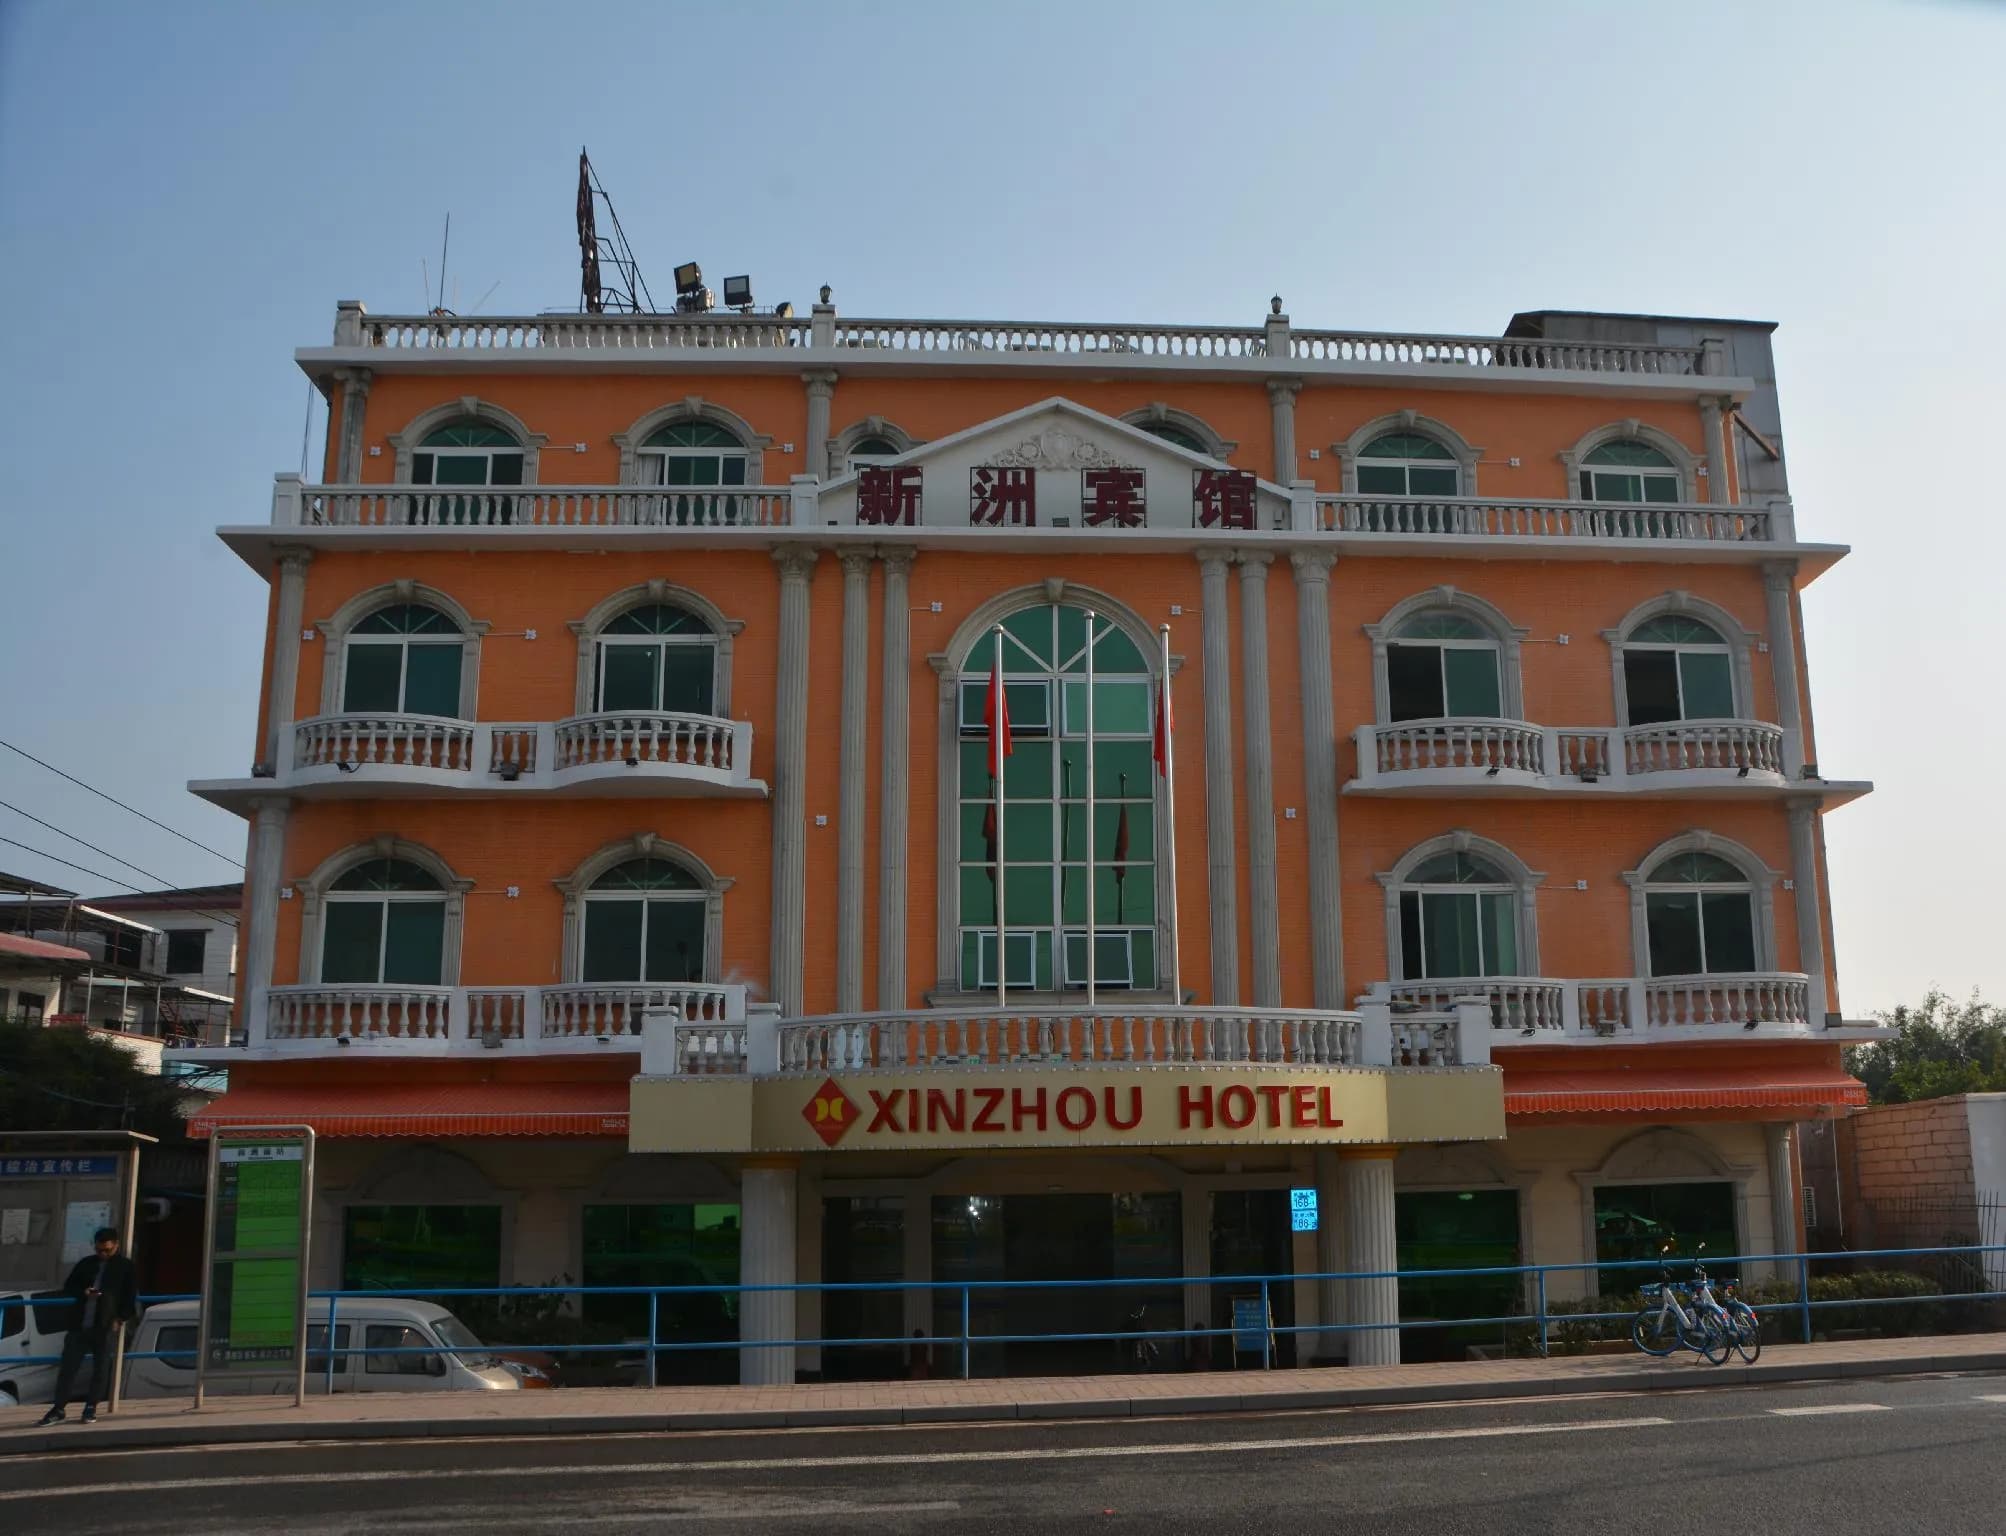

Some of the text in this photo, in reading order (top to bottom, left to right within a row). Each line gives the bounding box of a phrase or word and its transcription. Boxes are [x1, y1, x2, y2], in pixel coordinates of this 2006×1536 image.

[858, 465, 1257, 530] 新洲宾馆
[867, 1085, 1344, 1132] XINZHOU HOTEL
